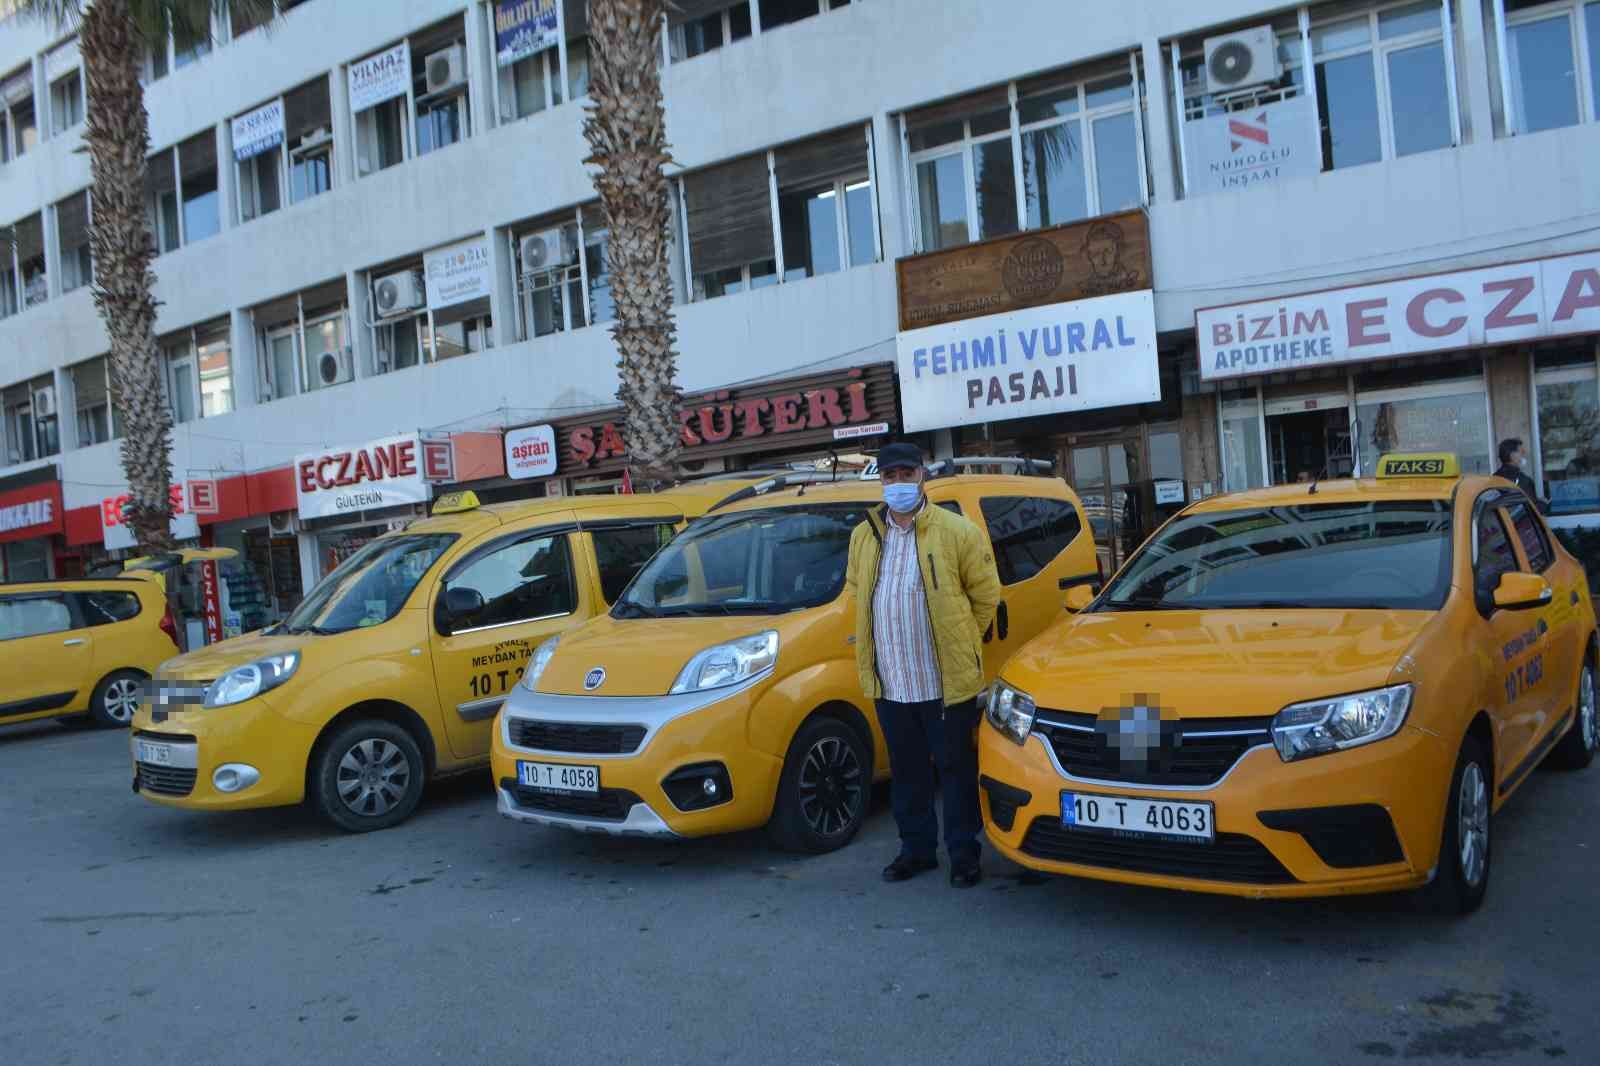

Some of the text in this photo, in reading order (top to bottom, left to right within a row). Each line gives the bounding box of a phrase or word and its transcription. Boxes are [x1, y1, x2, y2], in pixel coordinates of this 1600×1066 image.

[352, 47, 405, 80] YILMAZ
[1212, 306, 1329, 346] BİZİM
[913, 315, 1136, 378] FEHMİ VURAL
[1215, 337, 1333, 369] APOTHEKE
[966, 363, 1078, 408] PASAJI
[569, 368, 871, 467] ŞAKÜTERİ
[300, 440, 416, 492] ECZANE
[426, 447, 449, 477] E
[512, 441, 550, 460] aşran
[192, 485, 210, 504] E
[336, 489, 383, 509] GÜLTEKİN
[472, 651, 516, 668] MEYDAN
[470, 673, 492, 697] 10
[497, 670, 509, 691] T
[526, 765, 595, 787] 10 T 4058
[1075, 799, 1099, 822] 10
[1115, 802, 1128, 825] T
[1146, 805, 1206, 831] 4063
